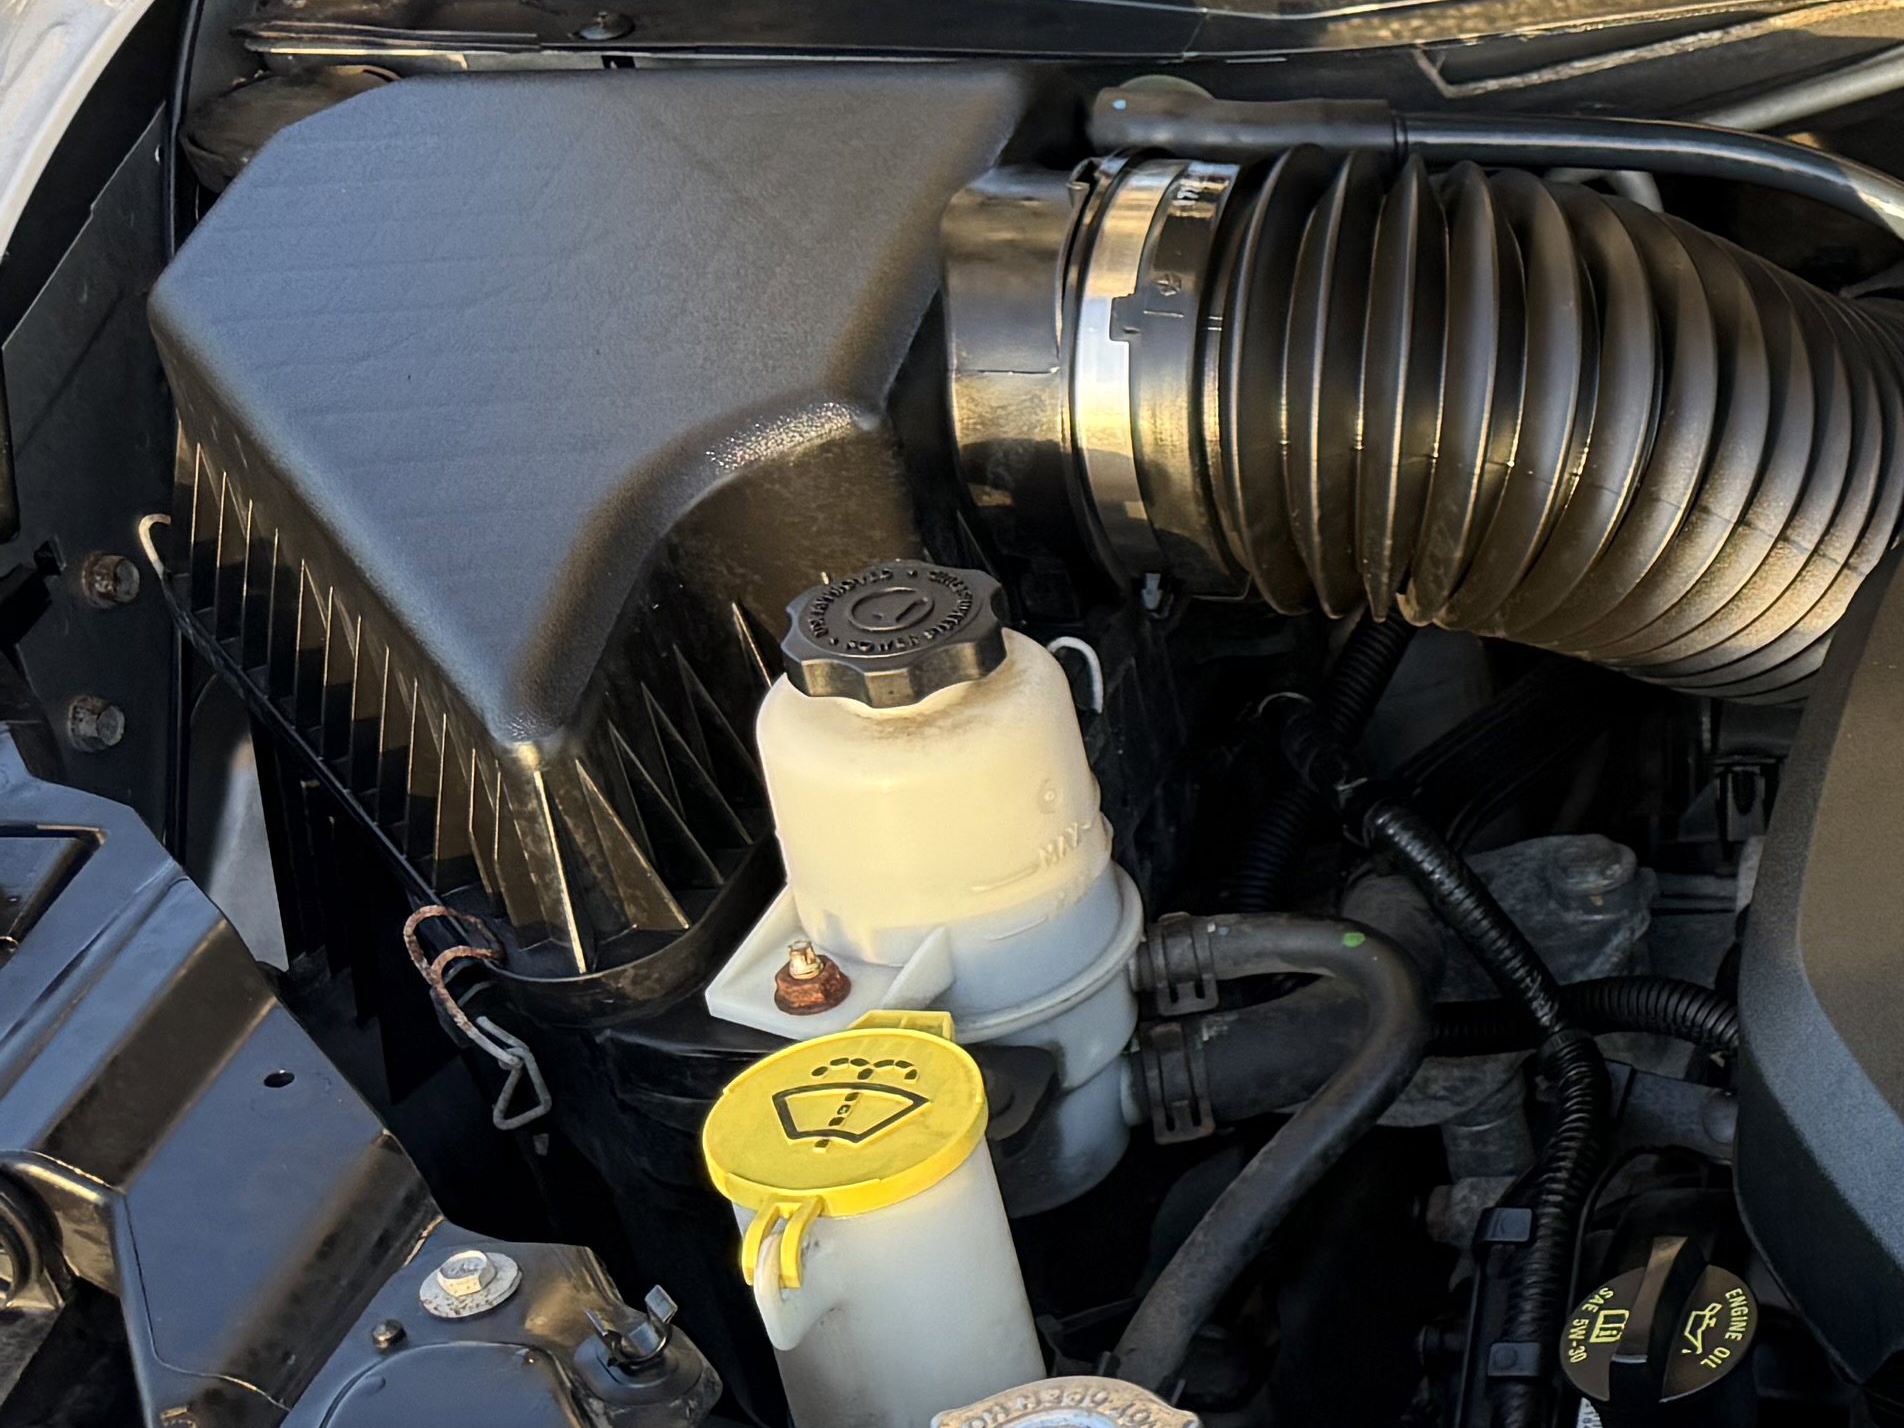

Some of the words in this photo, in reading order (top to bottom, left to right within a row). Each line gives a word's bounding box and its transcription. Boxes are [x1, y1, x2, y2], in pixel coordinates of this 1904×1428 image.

[1582, 1287, 1615, 1312] SAE
[1724, 1287, 1749, 1341] ENGINE
[1568, 1318, 1590, 1364] 5W-30
[1700, 1346, 1731, 1369] OIL
